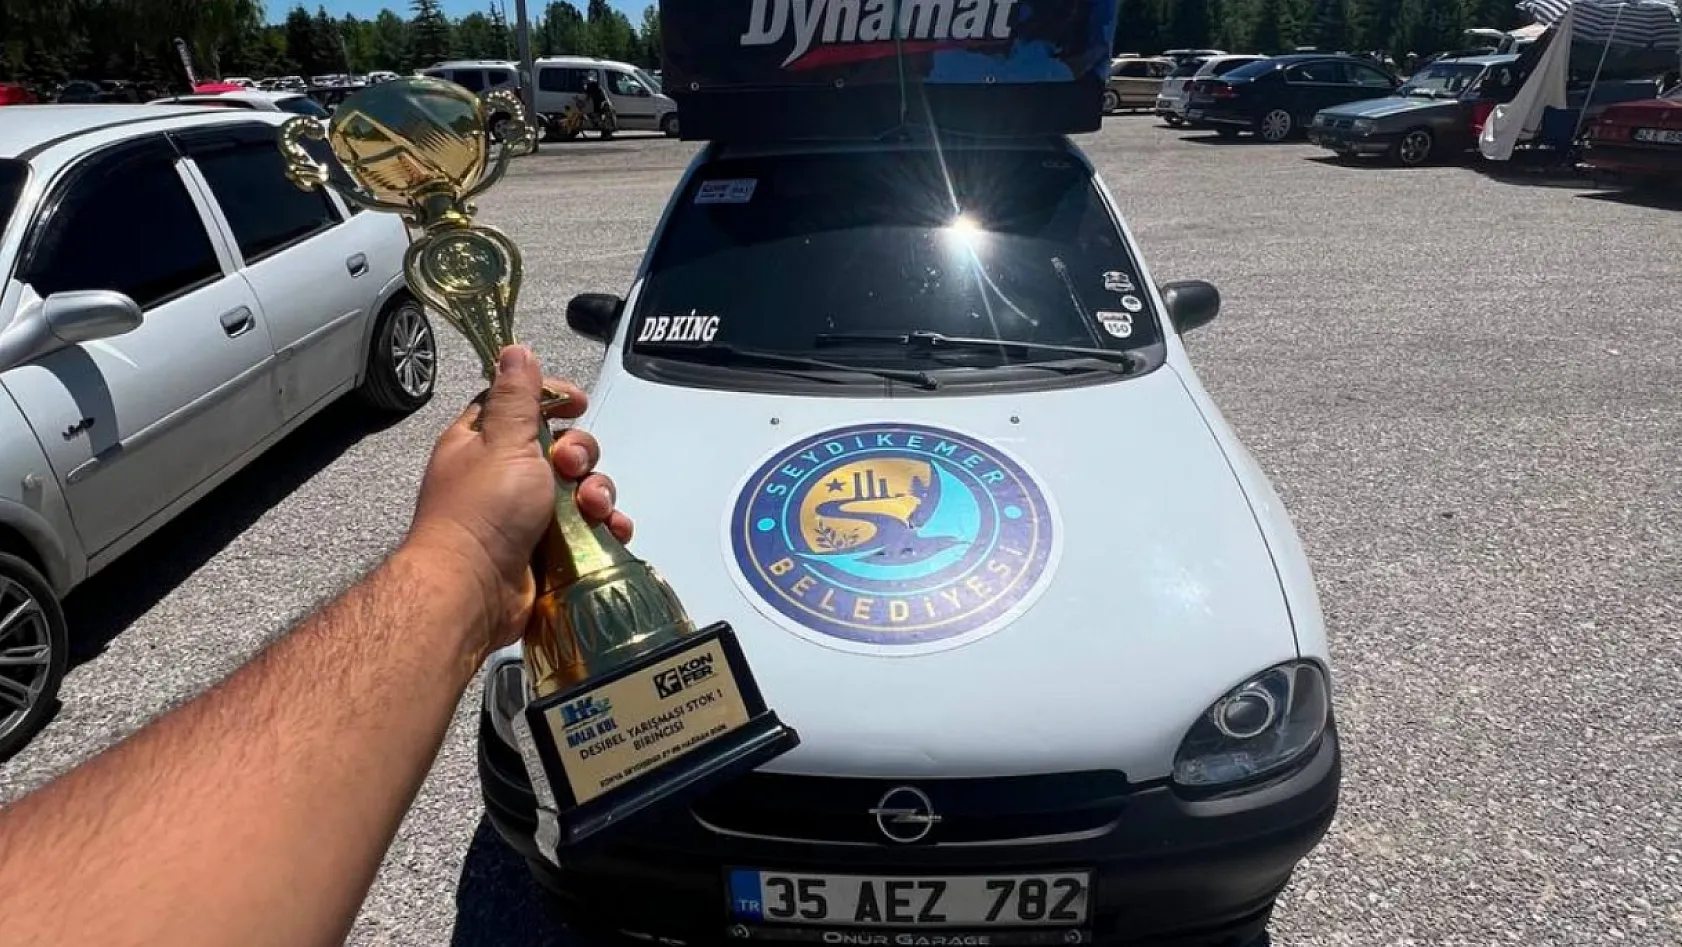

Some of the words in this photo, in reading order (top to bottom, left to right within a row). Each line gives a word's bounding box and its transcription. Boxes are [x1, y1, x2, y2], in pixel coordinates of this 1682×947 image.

[740, 0, 1017, 69] Dynamat
[637, 316, 671, 341] DB
[678, 652, 714, 673] KON
[682, 665, 714, 688] FER
[686, 691, 716, 712] STOK
[738, 899, 760, 913] TR
[766, 877, 827, 919] 35
[854, 881, 948, 923] AEZ
[985, 878, 1083, 922] 782
